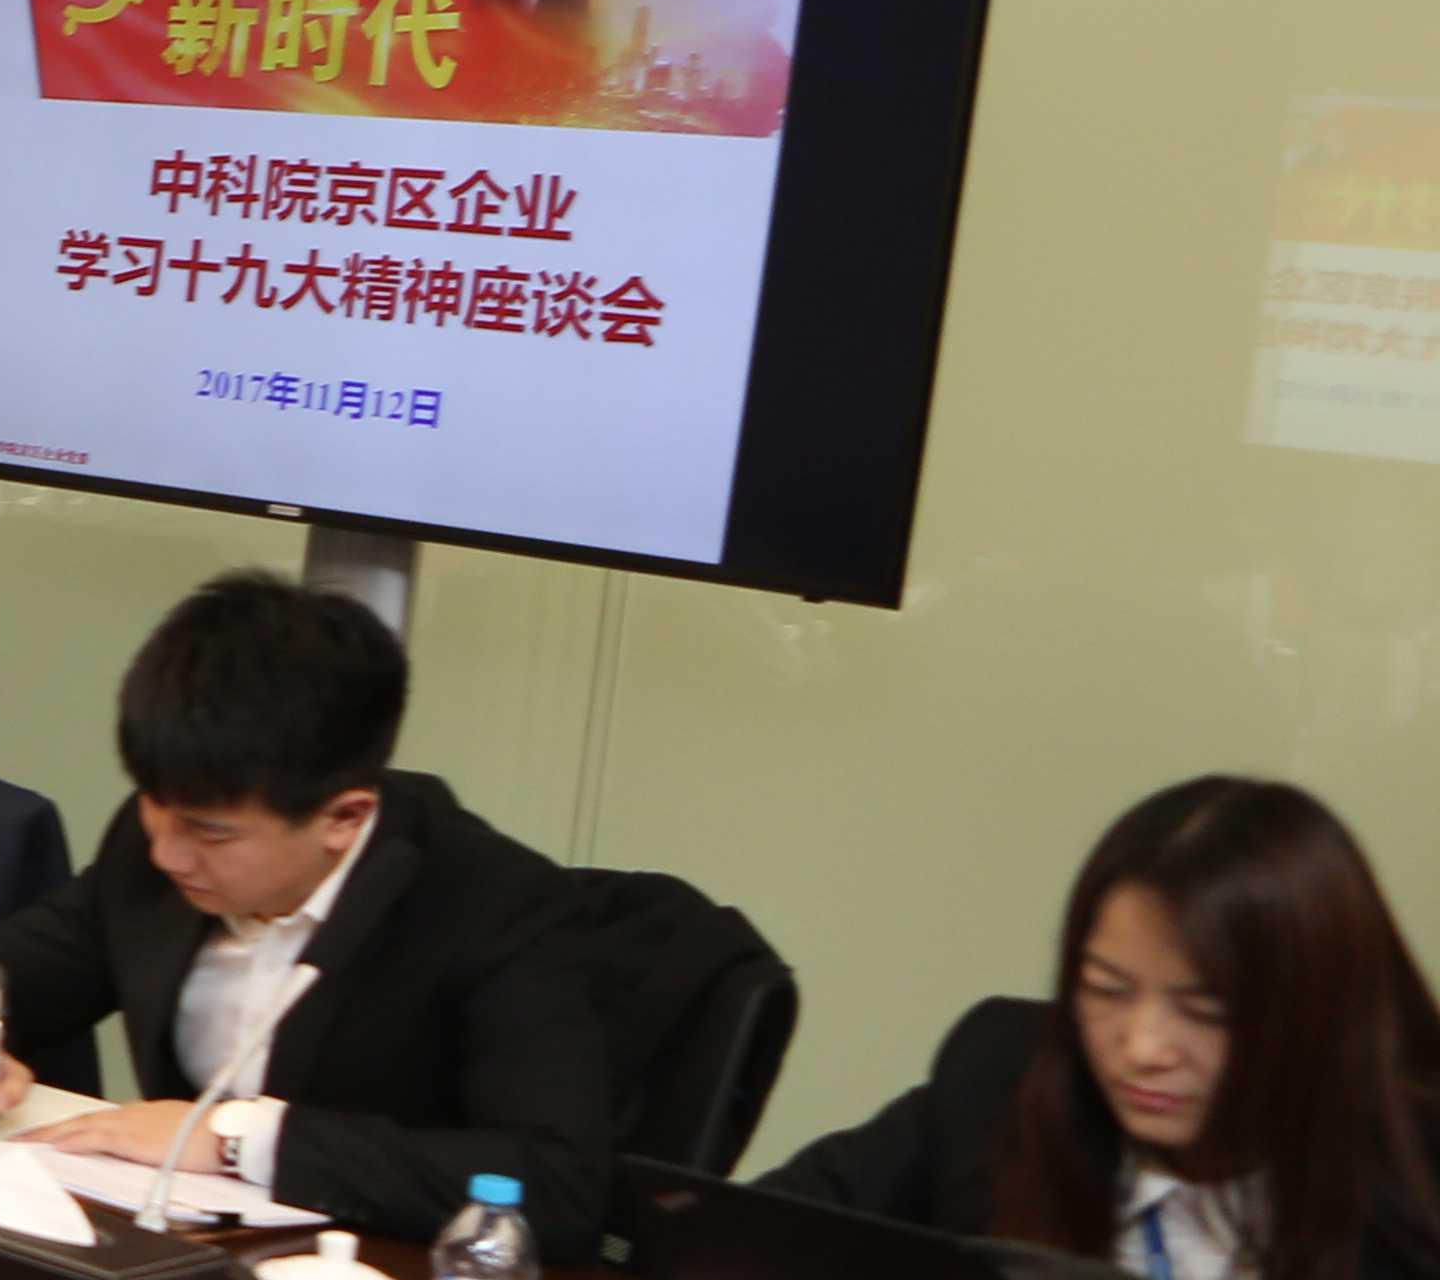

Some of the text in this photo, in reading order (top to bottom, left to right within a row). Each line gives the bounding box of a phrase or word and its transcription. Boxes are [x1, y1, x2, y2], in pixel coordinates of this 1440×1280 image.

[149, 149, 579, 244] 中科院京区企业
[54, 229, 667, 350] 学习十九大精神座谈会
[196, 366, 443, 429] 2017年11月12日
